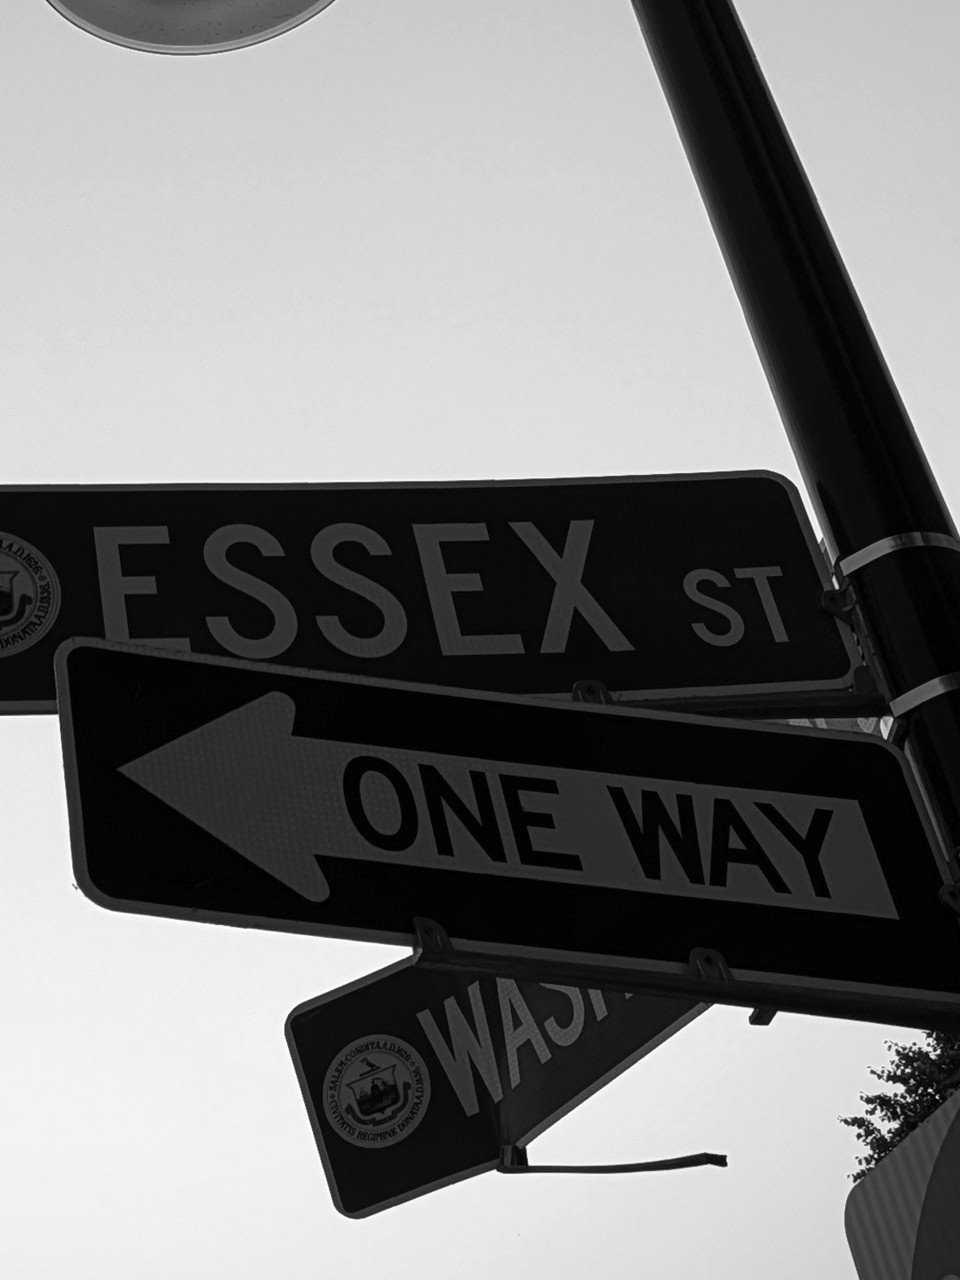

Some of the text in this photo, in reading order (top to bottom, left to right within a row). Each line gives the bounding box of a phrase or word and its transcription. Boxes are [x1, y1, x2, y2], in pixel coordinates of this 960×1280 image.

[93, 520, 790, 659] ESSEX ST
[342, 755, 835, 899] ONE WAY
[416, 977, 634, 1117] WAS
